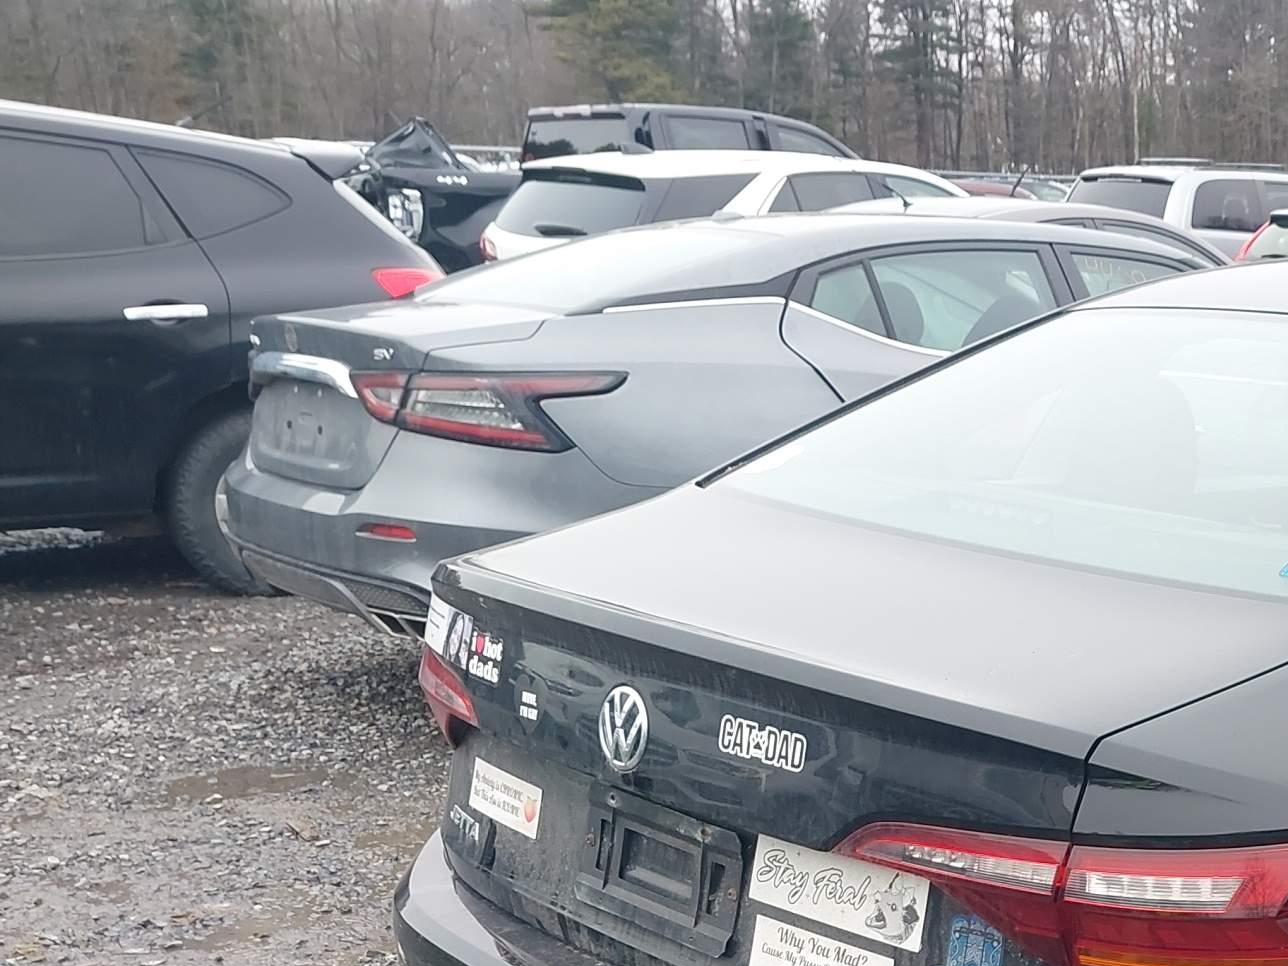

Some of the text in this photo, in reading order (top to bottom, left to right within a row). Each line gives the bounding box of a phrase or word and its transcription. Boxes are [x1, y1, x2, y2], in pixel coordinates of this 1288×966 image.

[373, 348, 394, 360] SV
[468, 655, 499, 683] dads
[719, 715, 806, 771] CAT DAD
[757, 849, 871, 911] Stay Feral
[761, 942, 784, 959] Cause
[785, 951, 797, 966] My
[778, 926, 805, 954] Why
[808, 937, 830, 959] You
